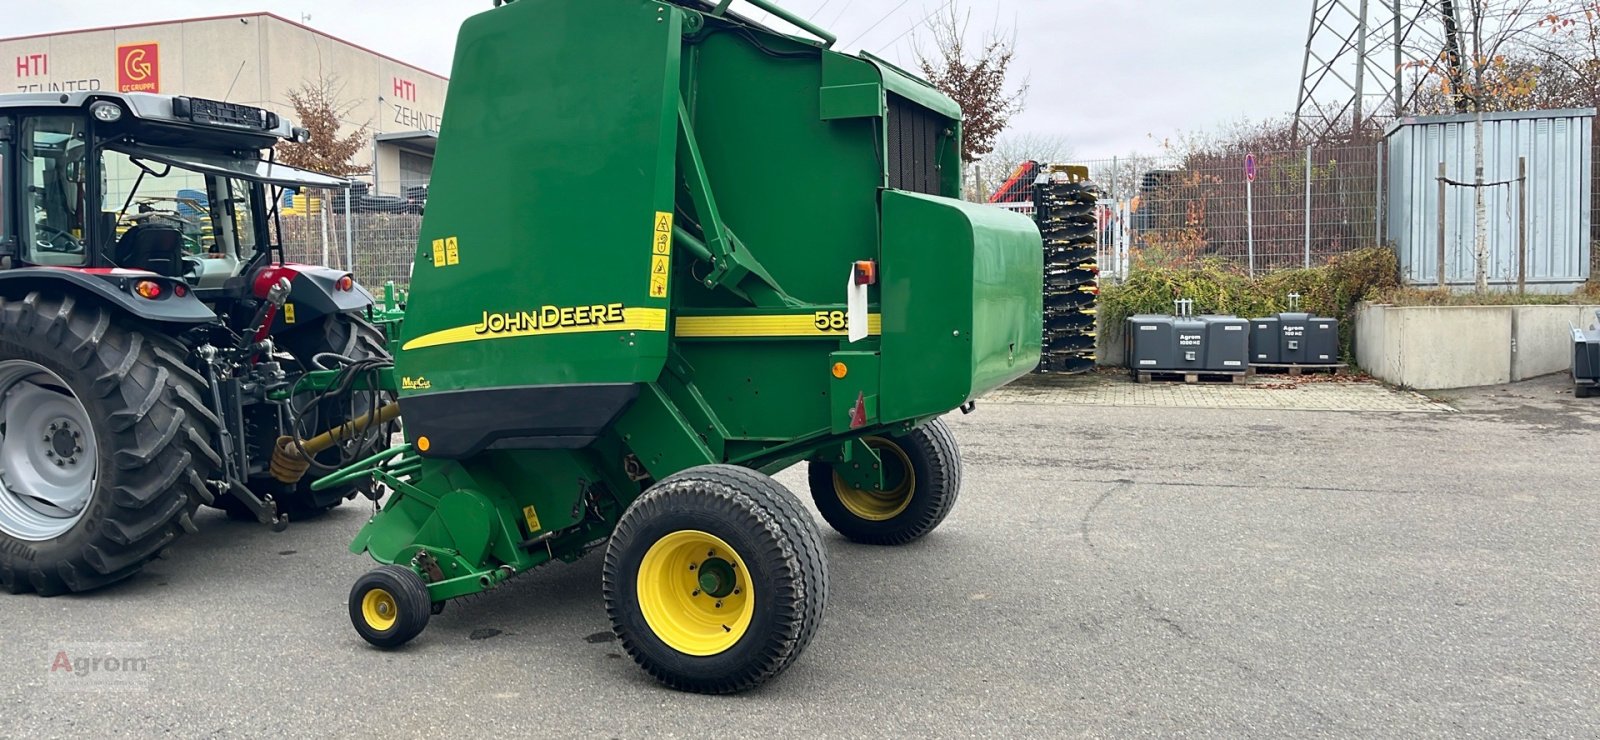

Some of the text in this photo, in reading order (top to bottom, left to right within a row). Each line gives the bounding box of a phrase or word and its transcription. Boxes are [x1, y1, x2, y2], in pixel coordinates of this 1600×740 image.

[16, 53, 48, 78] HTI
[130, 82, 156, 91] GRUPPE
[393, 76, 416, 103] HTI
[474, 302, 625, 335] JOHN DEERE
[814, 310, 849, 332] 58
